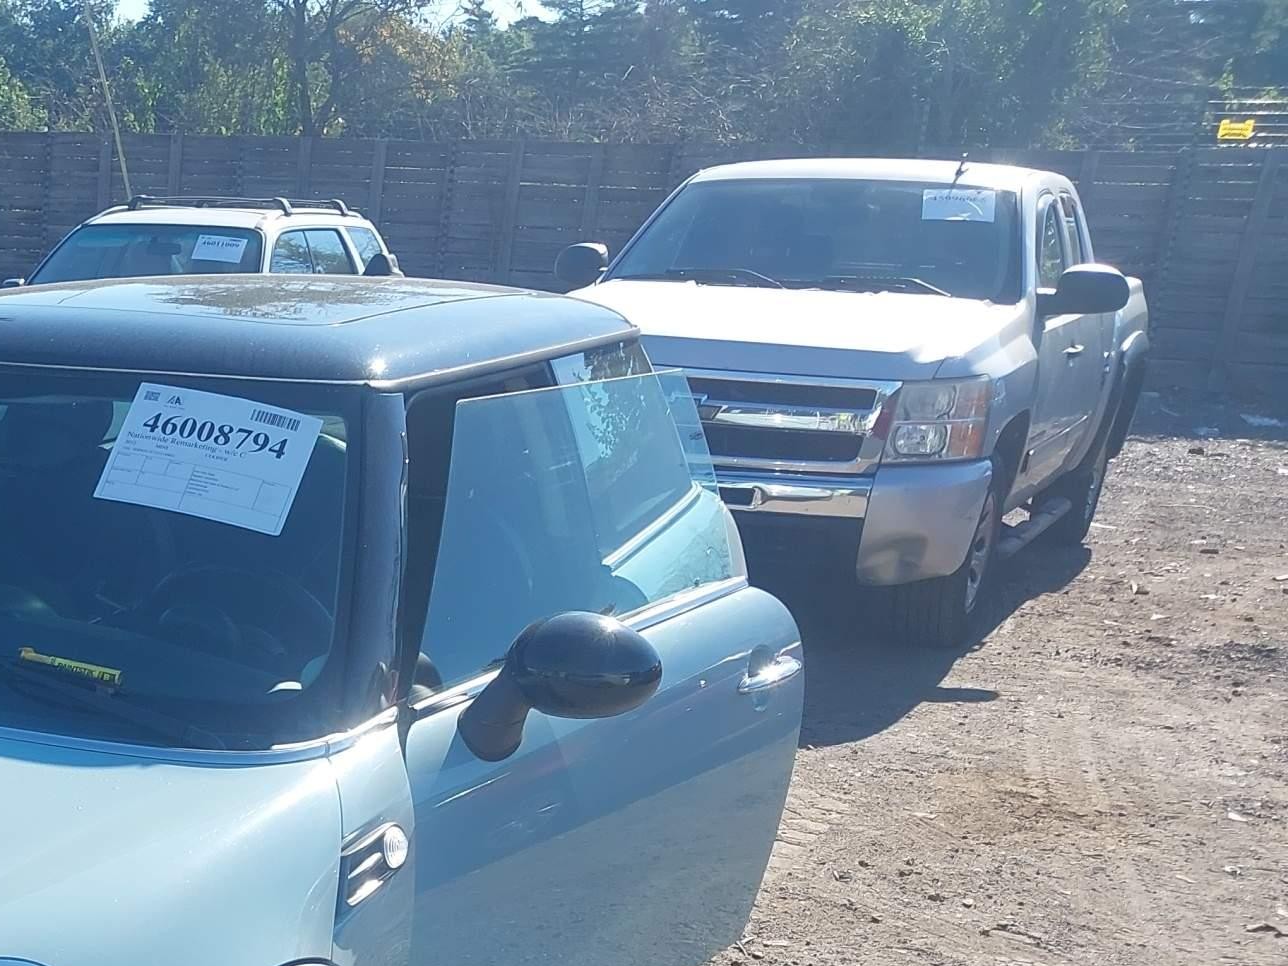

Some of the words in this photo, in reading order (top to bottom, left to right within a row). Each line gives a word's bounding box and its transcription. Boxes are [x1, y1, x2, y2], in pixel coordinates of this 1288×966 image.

[127, 431, 169, 443] Nationwide
[170, 437, 217, 453] Remarketing
[143, 412, 289, 459] 46008794
